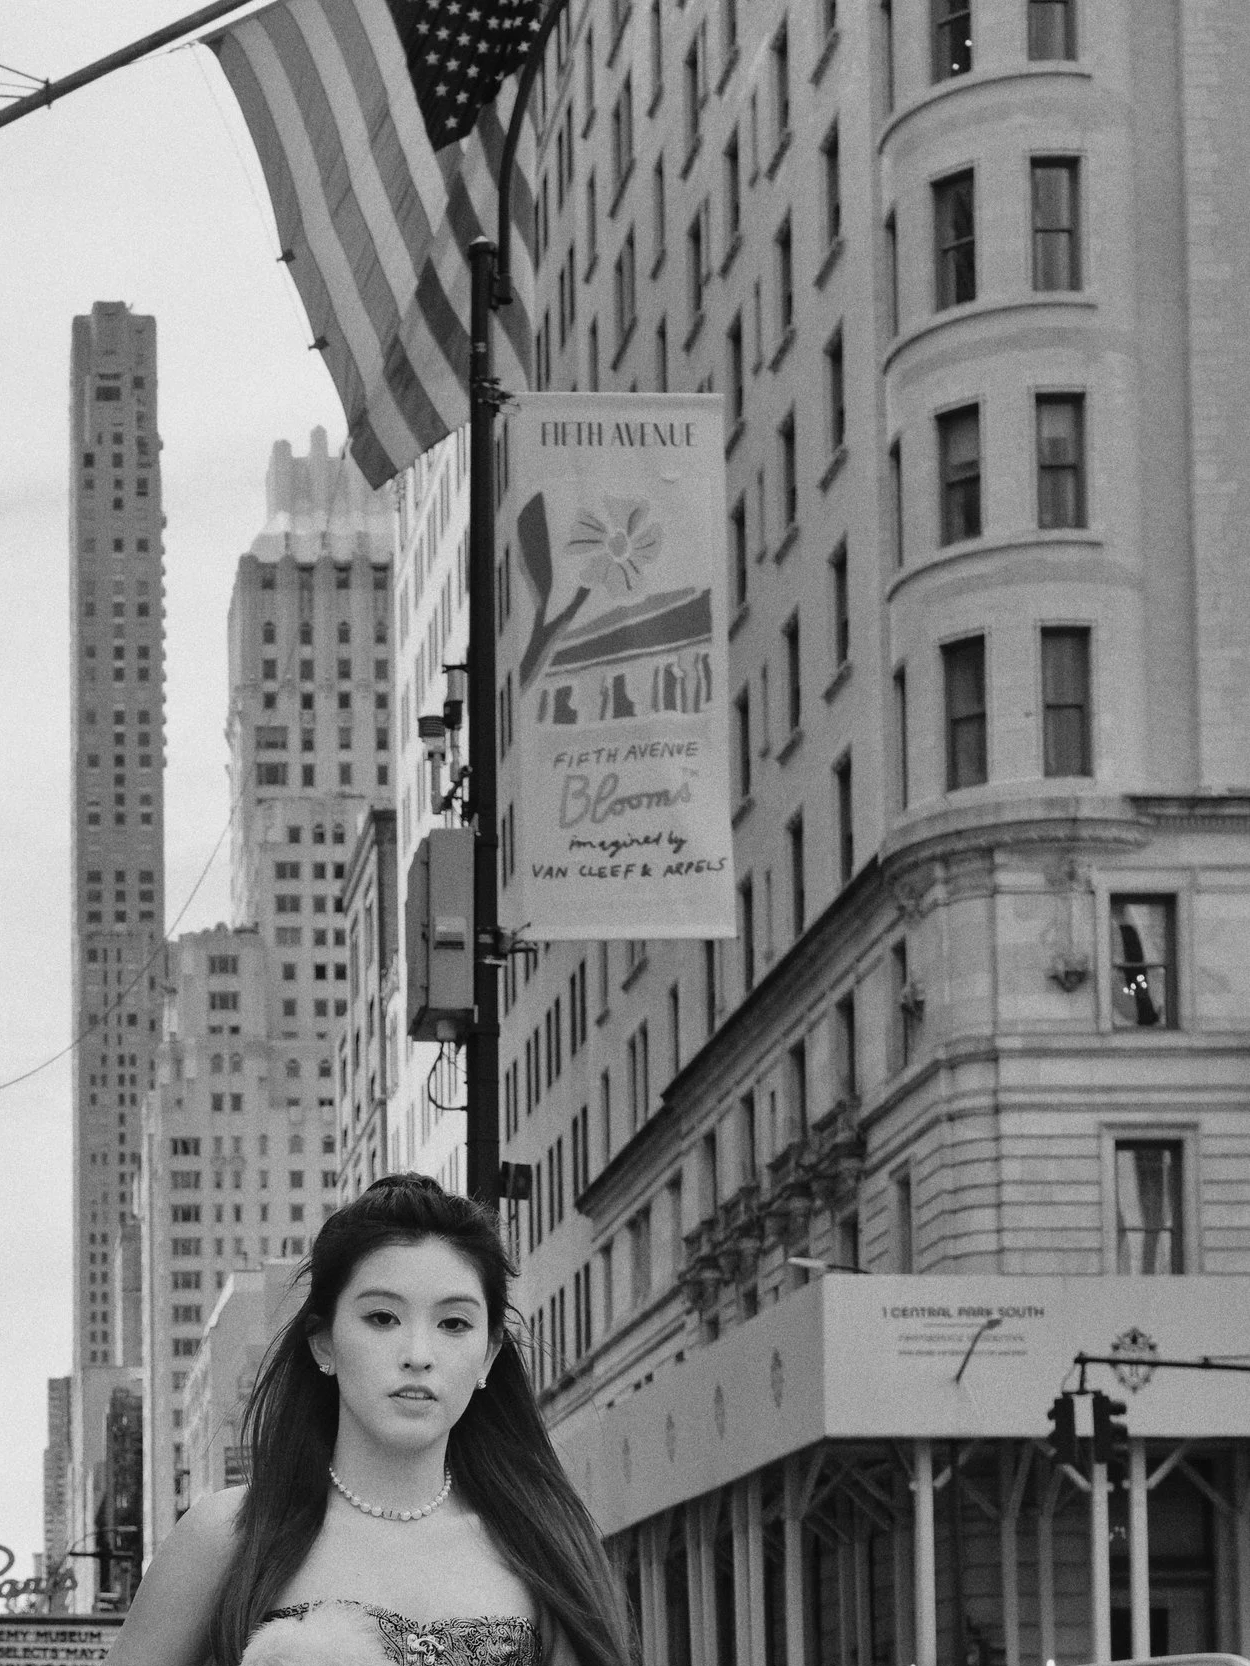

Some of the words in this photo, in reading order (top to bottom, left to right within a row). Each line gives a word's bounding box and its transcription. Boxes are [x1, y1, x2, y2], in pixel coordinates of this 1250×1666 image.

[540, 421, 603, 447] FIFTH
[610, 421, 698, 447] AVENUE
[553, 747, 619, 769] FIFTH
[623, 741, 700, 762] AVENUE
[559, 772, 692, 829] Blooms
[569, 832, 663, 858] imagined
[667, 831, 688, 855] by
[531, 864, 569, 879] VAN
[578, 863, 636, 879] CLEEF
[640, 863, 652, 878] &
[662, 857, 727, 878] ARPELS
[958, 1306, 993, 1317] PARK
[998, 1305, 1045, 1318] SOUTH
[36, 1630, 102, 1643] MUSEUM
